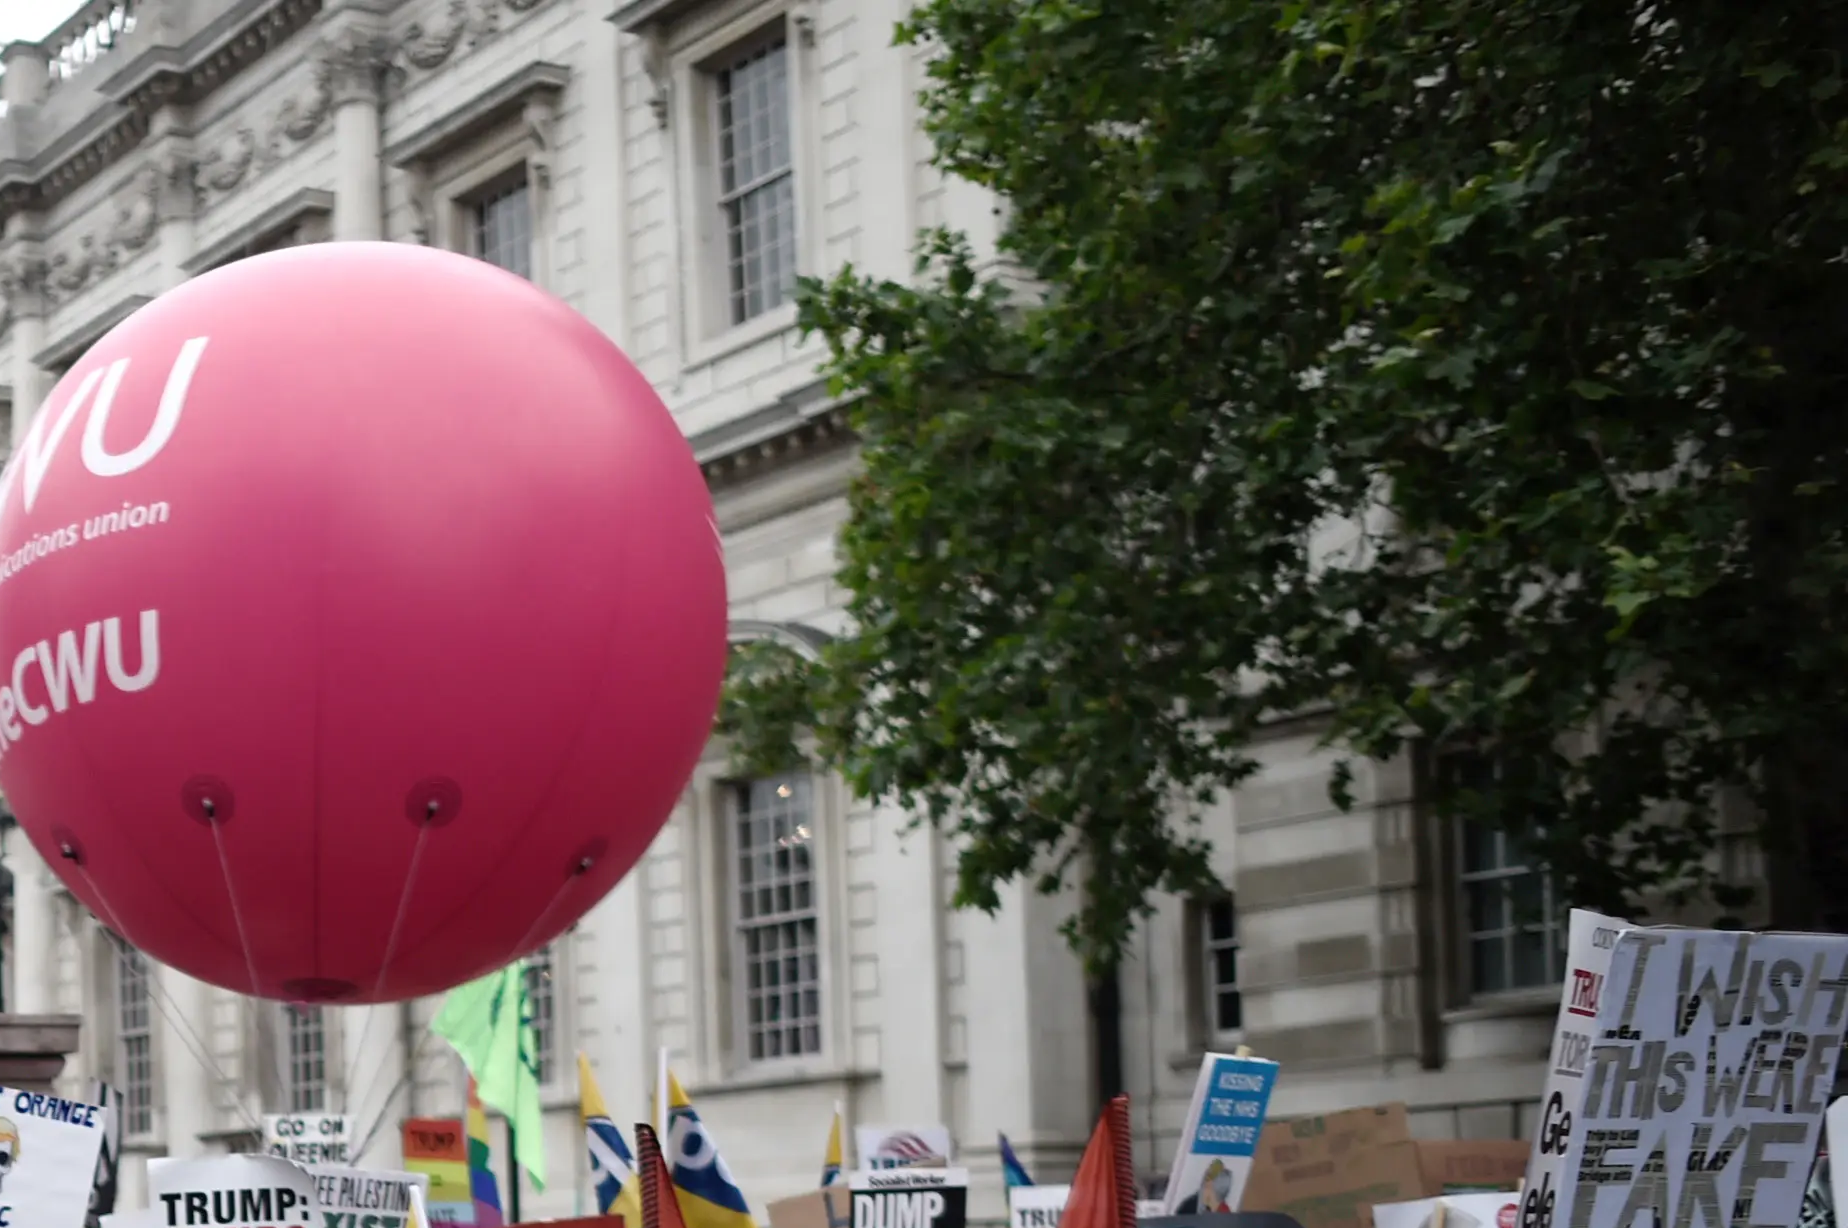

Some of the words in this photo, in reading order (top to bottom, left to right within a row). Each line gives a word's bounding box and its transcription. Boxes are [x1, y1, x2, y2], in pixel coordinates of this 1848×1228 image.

[82, 500, 170, 542] union
[1674, 930, 1848, 1040] WISH
[1583, 1040, 1696, 1121] THIS
[1703, 1031, 1842, 1119] WERE
[14, 1090, 99, 1128] ORANGE
[1209, 1097, 1231, 1117] THE
[1196, 1123, 1258, 1145] GOODBYE
[160, 1187, 311, 1227] TRUMP:
